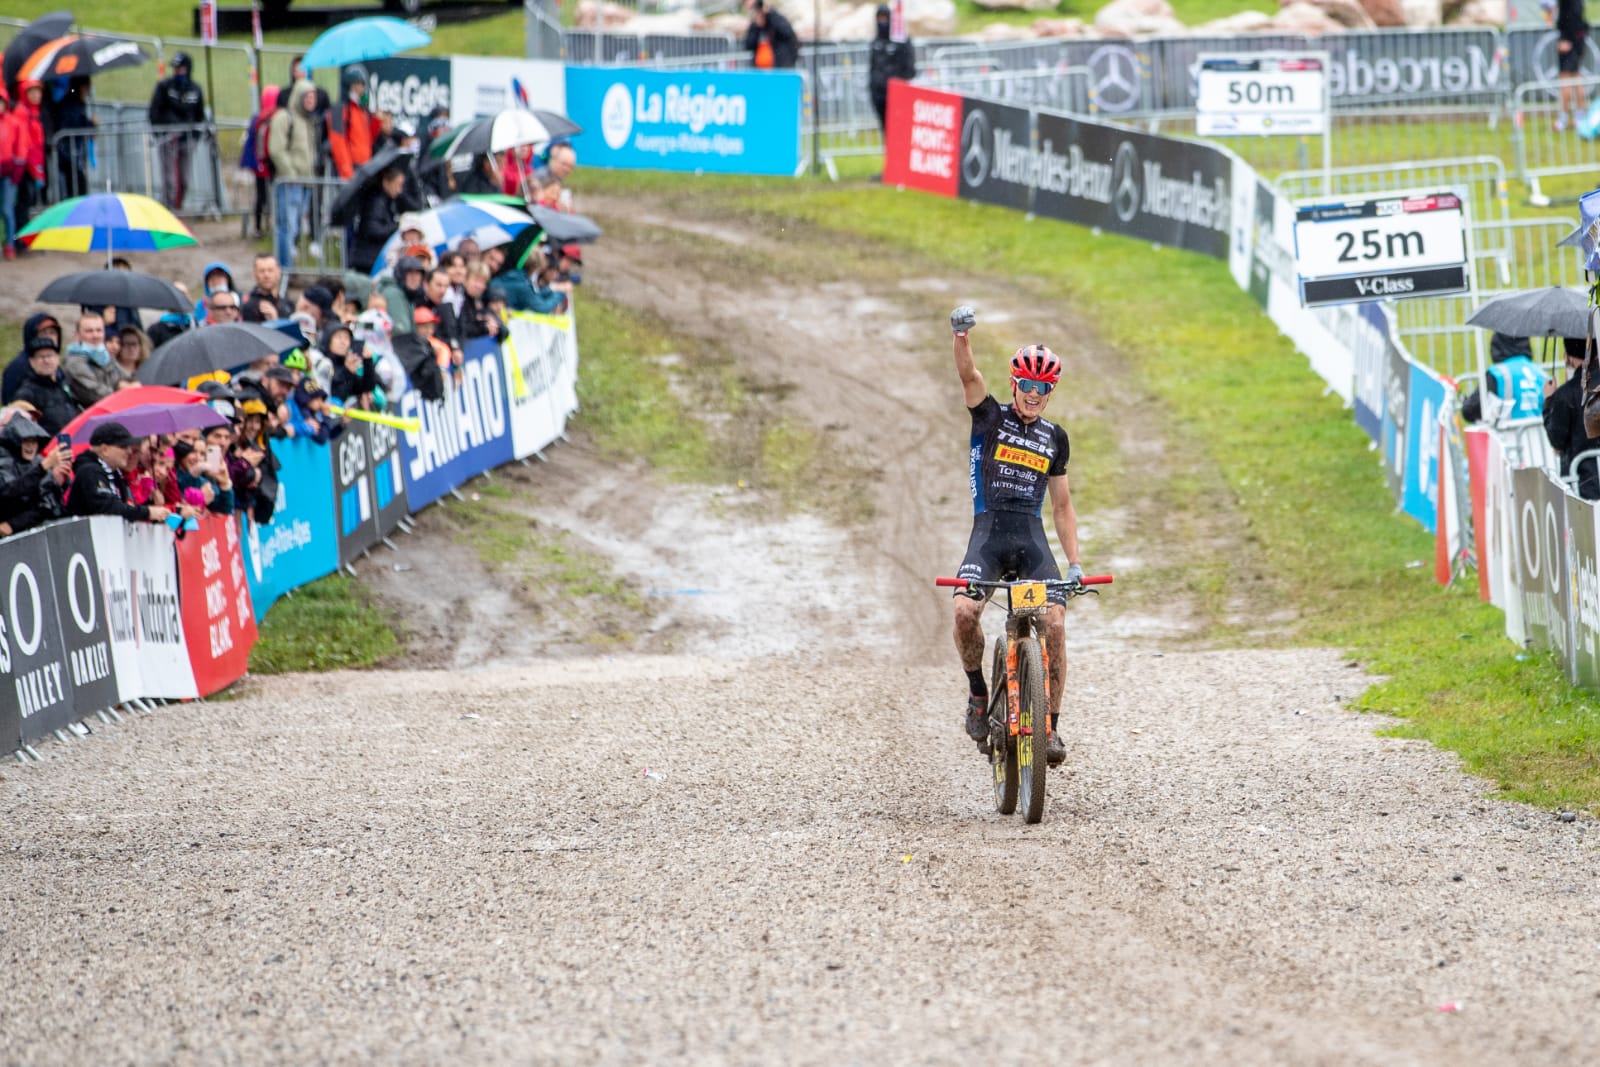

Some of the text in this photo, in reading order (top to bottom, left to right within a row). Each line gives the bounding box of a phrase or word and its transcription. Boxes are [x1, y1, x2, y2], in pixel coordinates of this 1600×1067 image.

[635, 82, 747, 133] La Région
[1228, 81, 1294, 104] 50m
[991, 127, 1113, 205] Mercedes-Benz
[1335, 229, 1425, 263] 25m
[1355, 277, 1415, 296] V-Class
[997, 428, 1054, 459] TREK
[1023, 588, 1035, 603] 4
[70, 641, 111, 687] OAKLEY
[15, 661, 64, 719] OAKLEY
